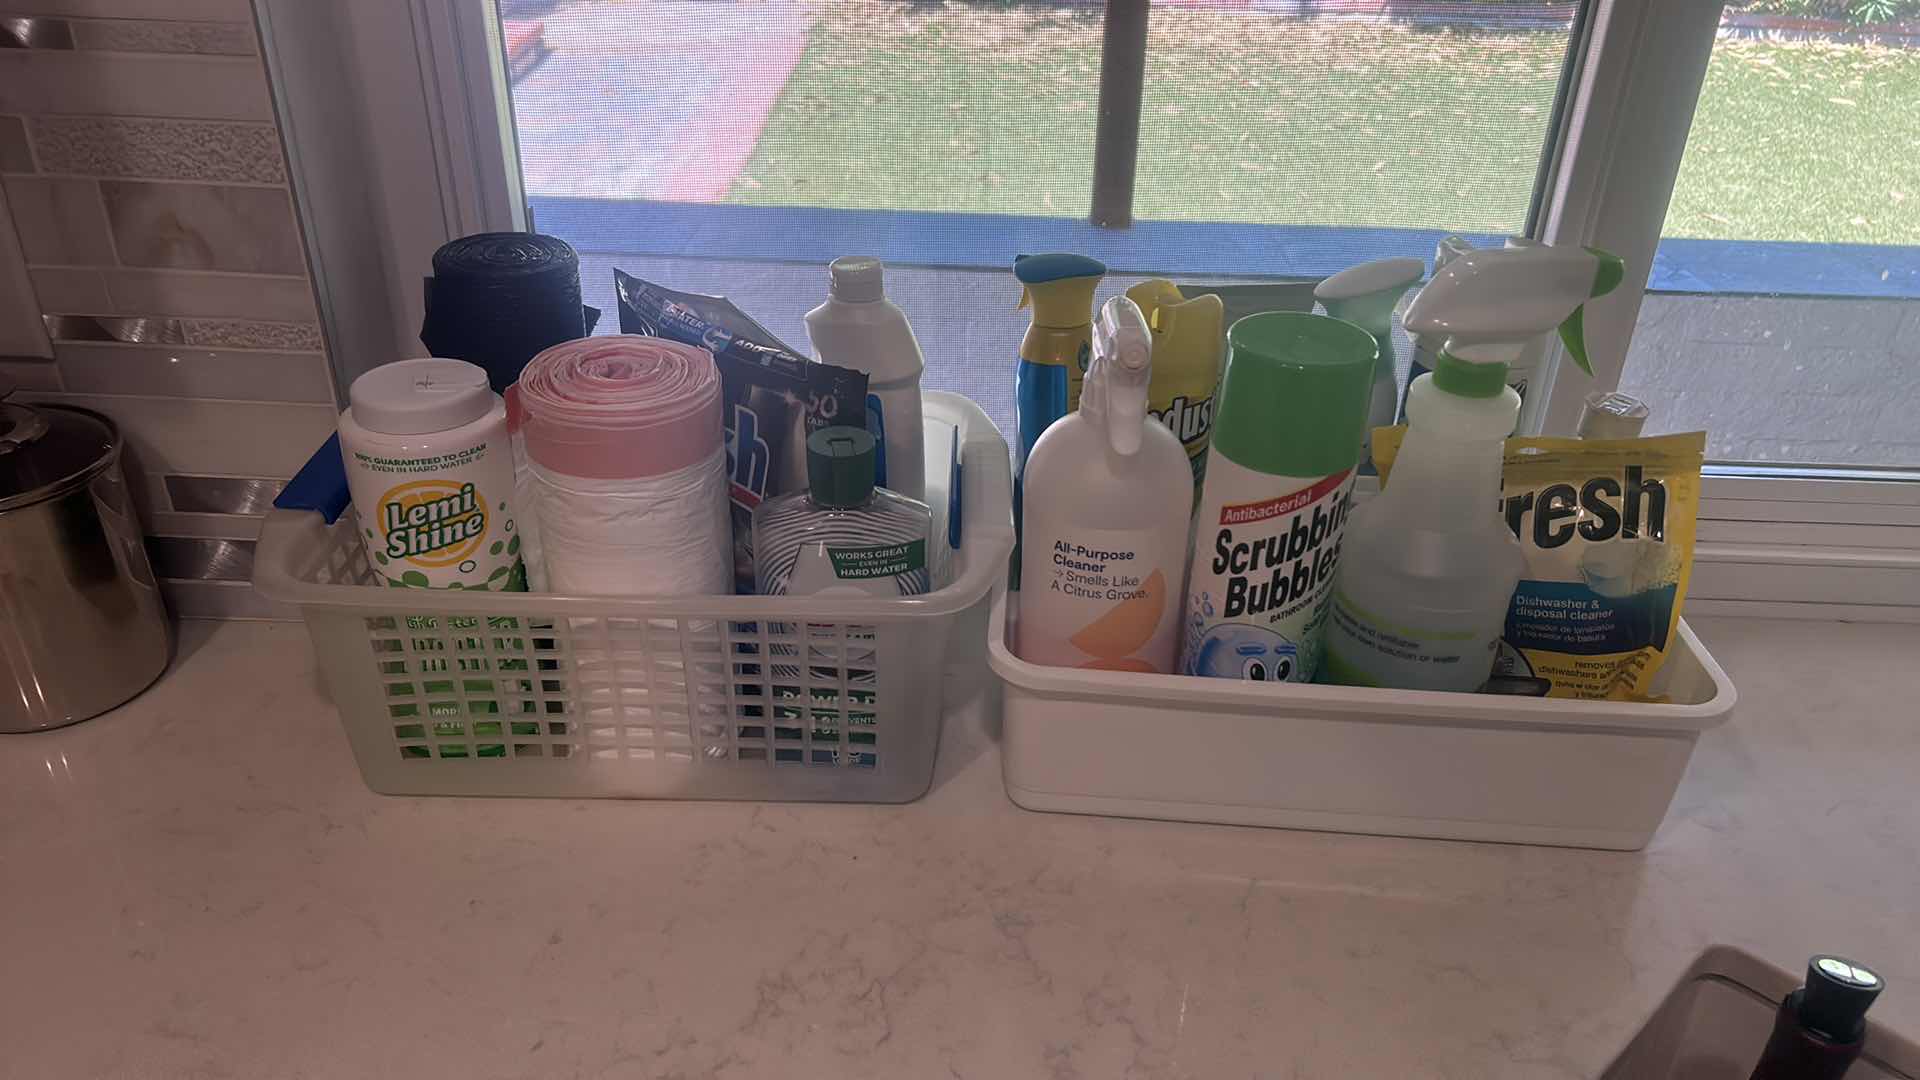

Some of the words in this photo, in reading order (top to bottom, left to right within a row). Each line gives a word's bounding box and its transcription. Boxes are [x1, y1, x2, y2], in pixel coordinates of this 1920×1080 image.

[371, 463, 394, 473] EVEN
[395, 464, 407, 473] IN
[408, 463, 438, 473] HARD
[440, 456, 473, 470] WATER
[374, 455, 441, 467] GUARANTEED
[442, 453, 457, 462] TO
[458, 442, 487, 459] CLEAN
[385, 483, 476, 529] Lemi
[1224, 490, 1313, 523] Antibacterial
[1498, 464, 1667, 549] resh
[386, 511, 484, 559] Shine
[1212, 489, 1354, 575] Scrubbin
[834, 550, 874, 561] WORKS
[874, 545, 910, 559] GREAT
[1053, 540, 1135, 562] All-Purpose
[840, 567, 870, 577] HARD
[870, 562, 909, 577] WATER
[1053, 554, 1106, 573] Cleaner
[1066, 570, 1110, 588] Smells
[1111, 575, 1141, 588] Like
[1223, 532, 1343, 619] Bubbles
[1050, 579, 1061, 592] A
[1063, 582, 1103, 600] Citrus
[1515, 594, 1587, 609] Dishwasher
[1590, 599, 1600, 609] &
[1514, 607, 1567, 620] disposal
[1569, 609, 1614, 621] cleaner
